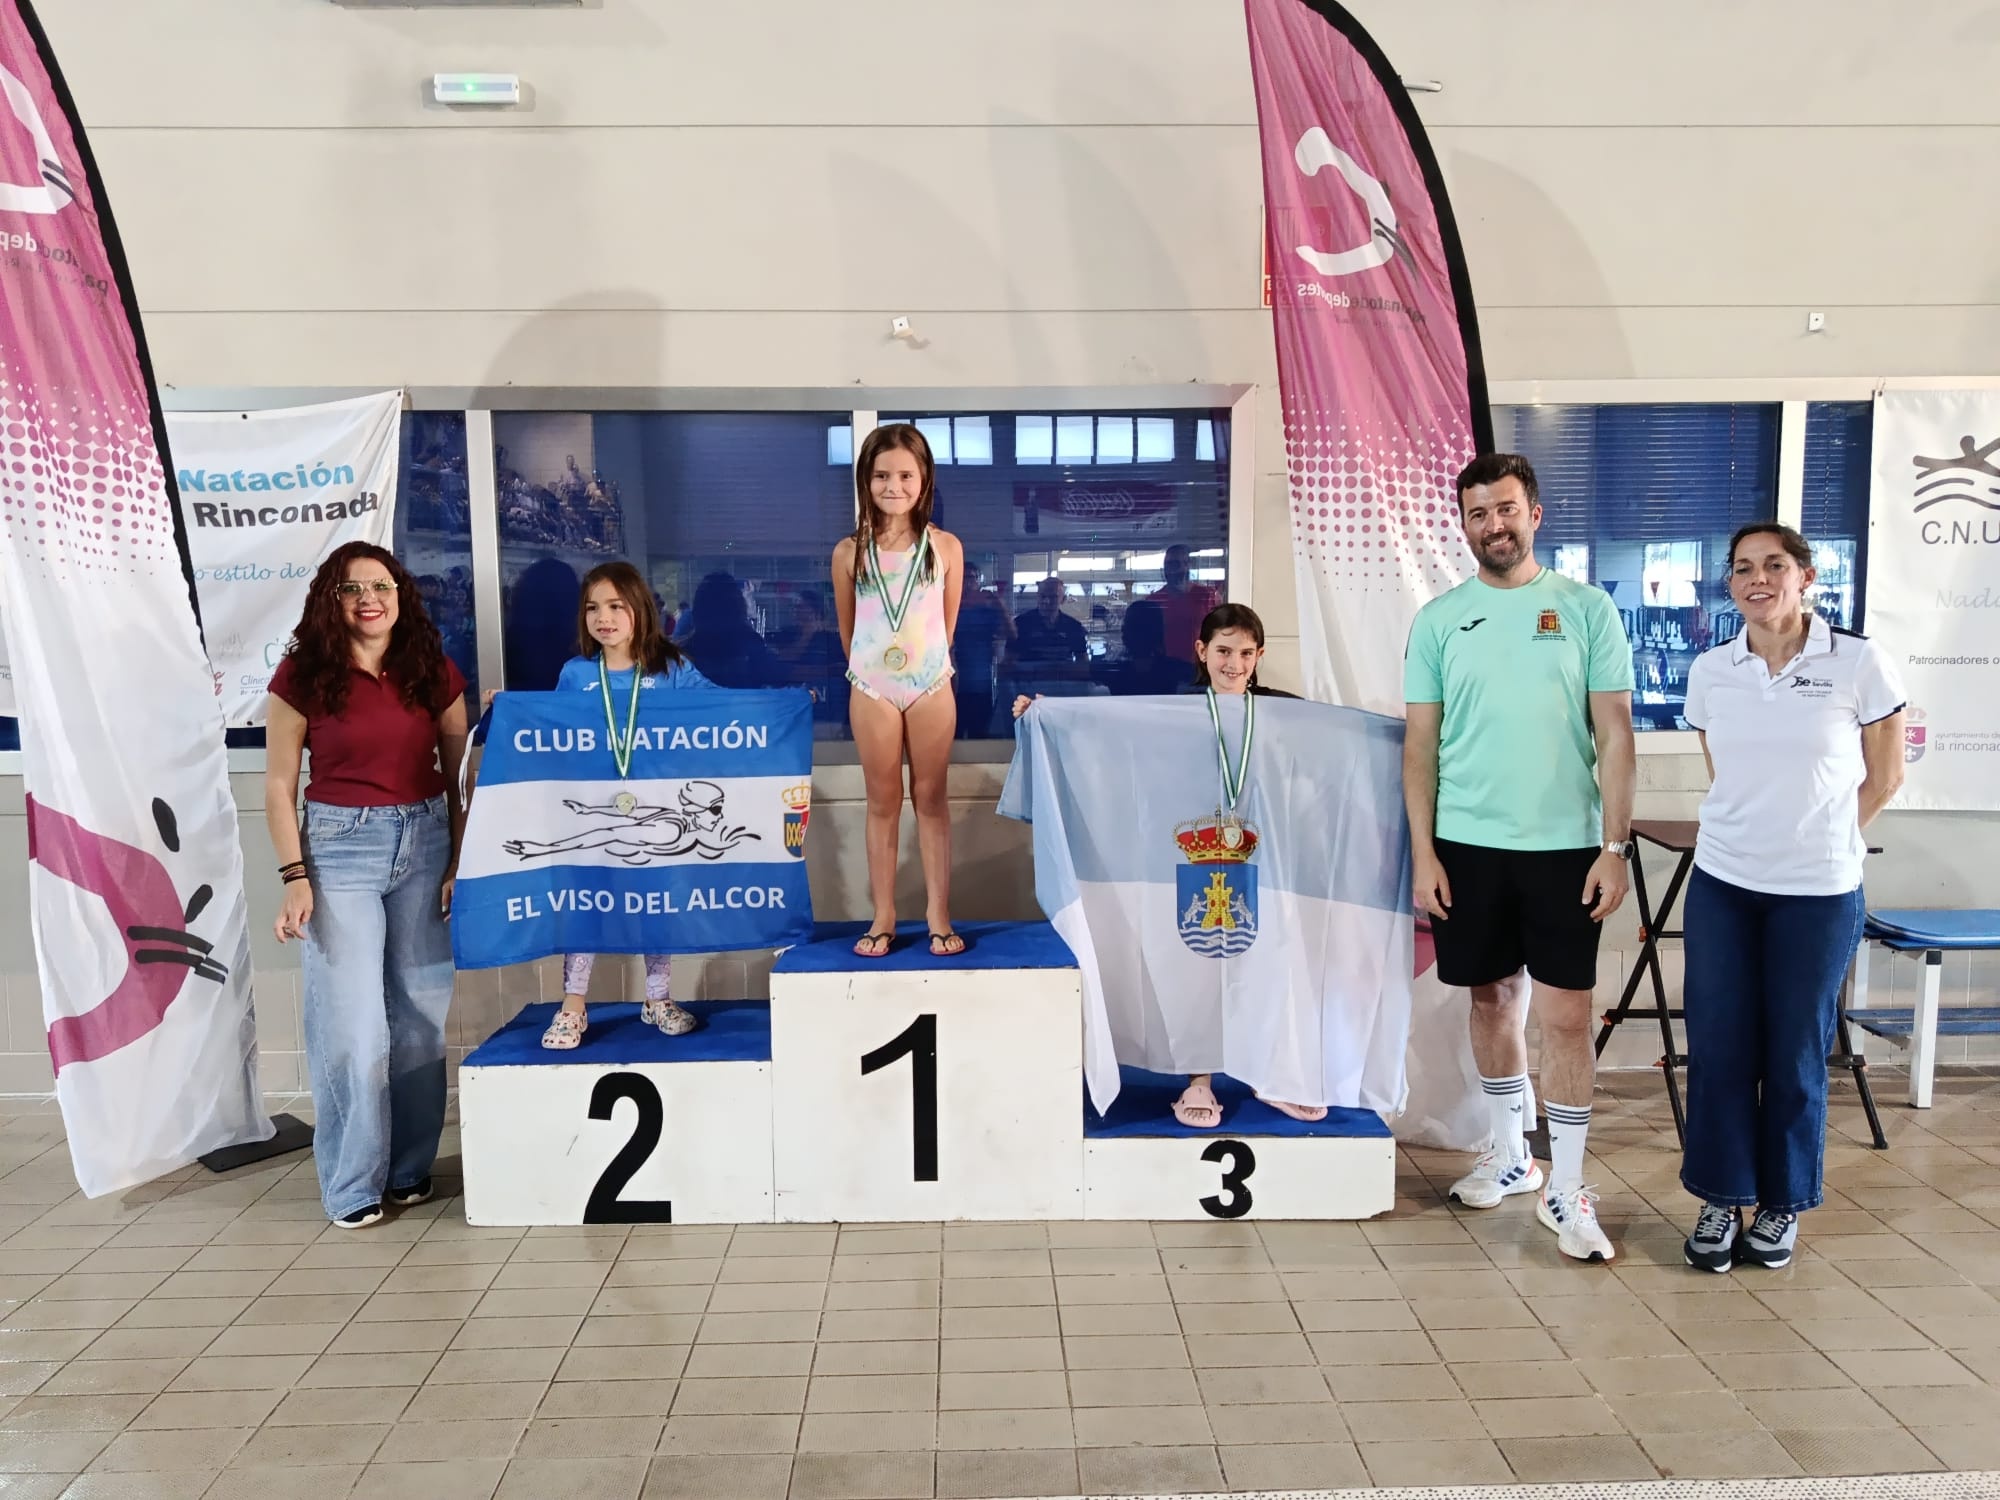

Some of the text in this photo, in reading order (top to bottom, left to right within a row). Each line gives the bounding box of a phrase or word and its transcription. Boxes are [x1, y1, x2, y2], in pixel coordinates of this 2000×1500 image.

[178, 461, 354, 493] Natación
[193, 492, 379, 528] Rinconada
[213, 563, 274, 582] estilo
[280, 562, 311, 580] de
[1909, 655, 1989, 665] Patrocinadores
[513, 720, 768, 753] CLUB NATACIÓN
[1935, 740, 1946, 752] la
[506, 886, 786, 922] EL VISO DEL ALCOR
[861, 1013, 939, 1182] 1
[583, 1072, 672, 1224] 2
[1199, 1139, 1256, 1219] 3
